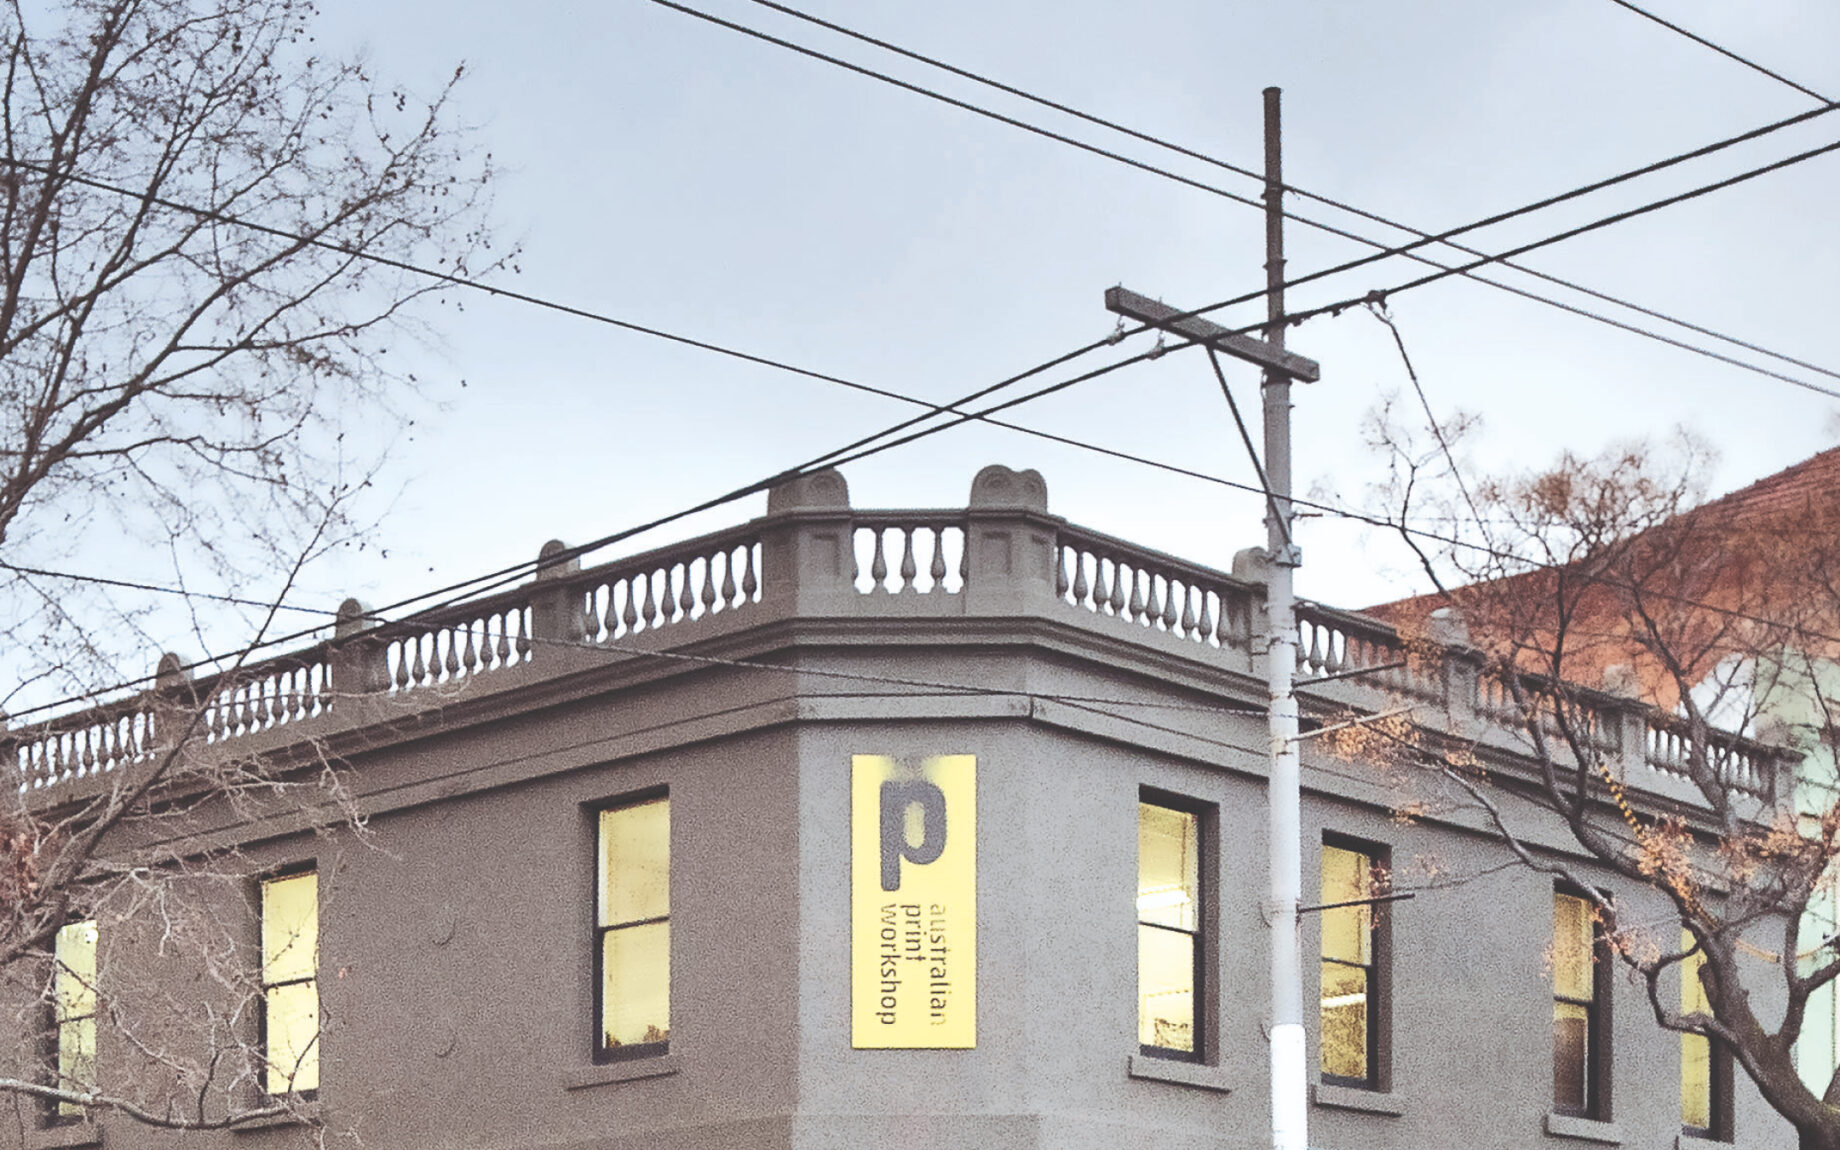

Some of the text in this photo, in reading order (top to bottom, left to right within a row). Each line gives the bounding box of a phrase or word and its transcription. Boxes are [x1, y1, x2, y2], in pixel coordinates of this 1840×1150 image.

[875, 903, 902, 1025] workshop
[900, 904, 926, 961] print
[930, 904, 952, 1025] australian
